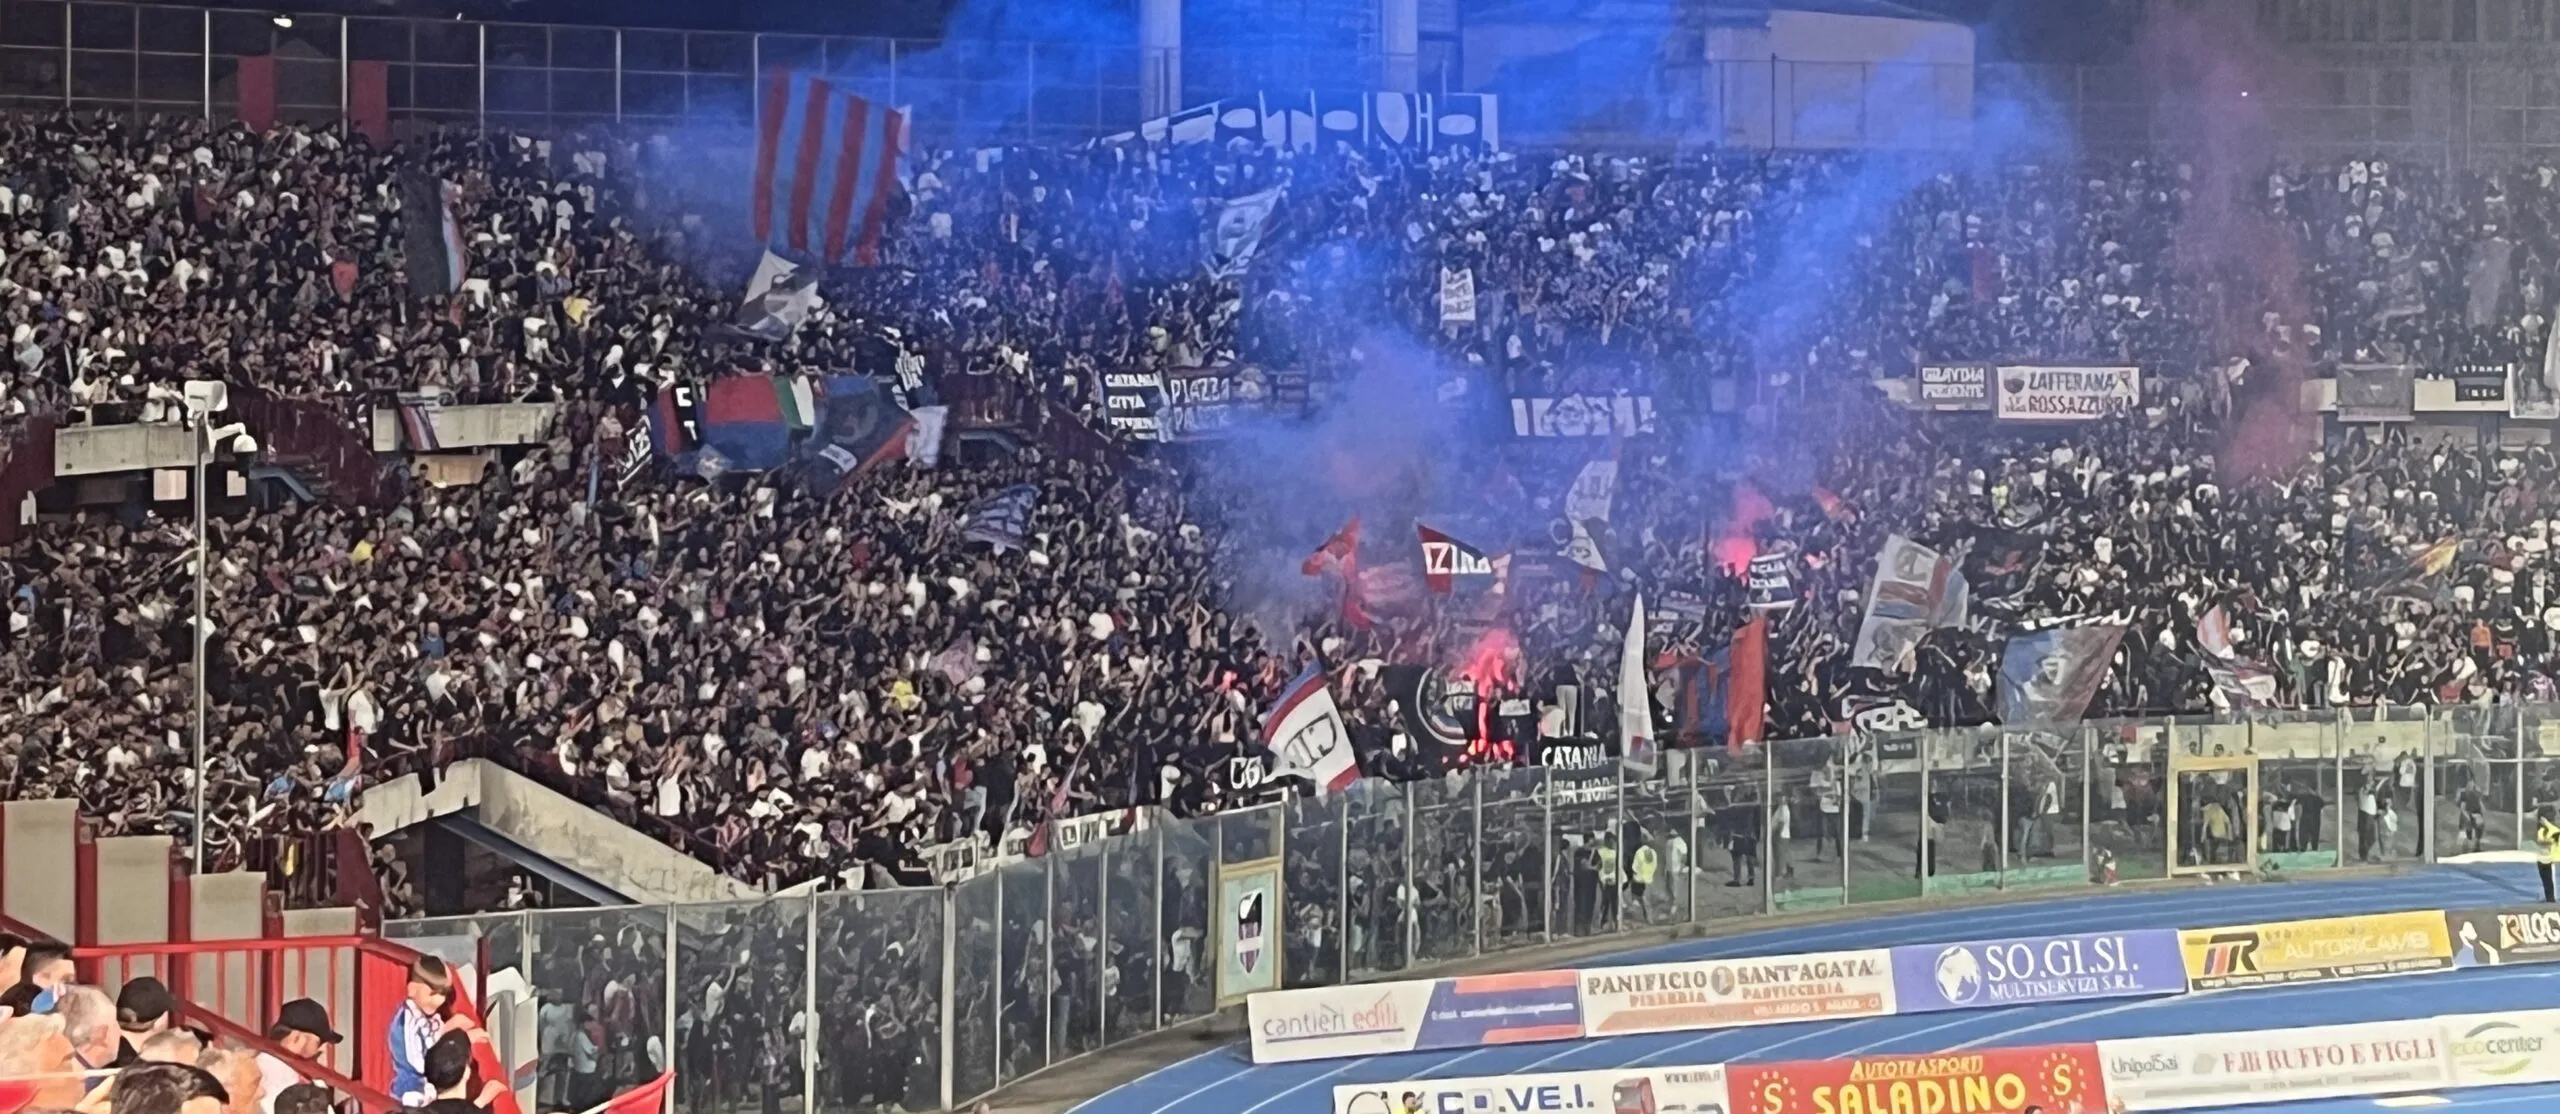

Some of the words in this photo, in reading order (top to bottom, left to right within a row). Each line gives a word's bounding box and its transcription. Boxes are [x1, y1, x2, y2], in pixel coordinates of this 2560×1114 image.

[1170, 376, 1230, 404] PIAZZA
[2029, 371, 2117, 392] ZAFFERANA
[2029, 395, 2134, 415] ROSSAZZURRA
[1542, 743, 1608, 771] CATANIA
[1985, 936, 2139, 981] SO.GI.SI.
[1587, 970, 1707, 996] PANIFICIO
[1737, 958, 1875, 984] SANT'AGATA
[1988, 976, 2098, 1000] MULTISERVIZI
[1263, 1002, 1346, 1037] cantieri
[2371, 1037, 2436, 1063] FIGLI
[1850, 1055, 1983, 1081] AUTOTRASPORTI
[2053, 1064, 2072, 1096] S
[1812, 1072, 2026, 1114] SALADINO
